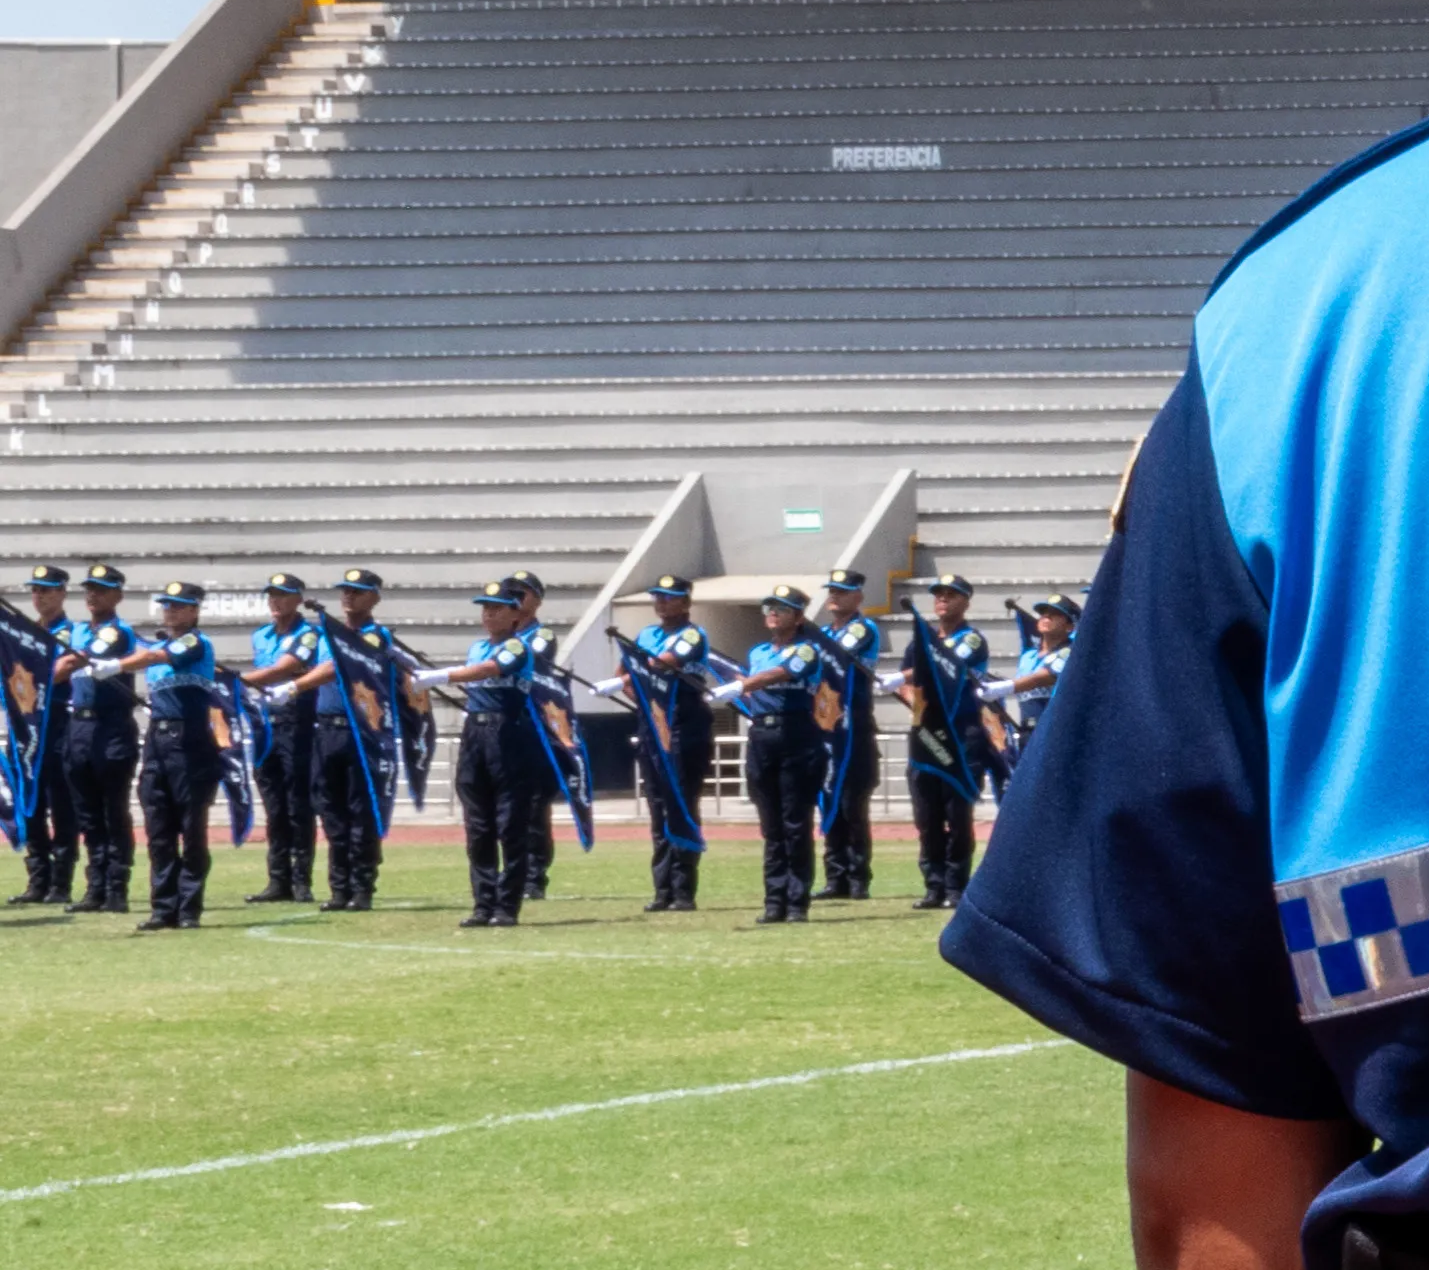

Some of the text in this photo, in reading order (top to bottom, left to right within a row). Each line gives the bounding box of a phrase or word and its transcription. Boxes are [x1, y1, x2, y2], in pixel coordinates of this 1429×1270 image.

[391, 15, 405, 34] Y
[361, 44, 382, 65] X
[343, 73, 366, 91] V
[315, 96, 333, 119] U
[300, 127, 319, 148] T
[266, 154, 281, 173] S
[832, 144, 941, 168] PREFERENCIA
[243, 182, 255, 204] R
[200, 241, 213, 264] P
[93, 364, 115, 386] M
[38, 393, 52, 416] L
[10, 428, 24, 450] K
